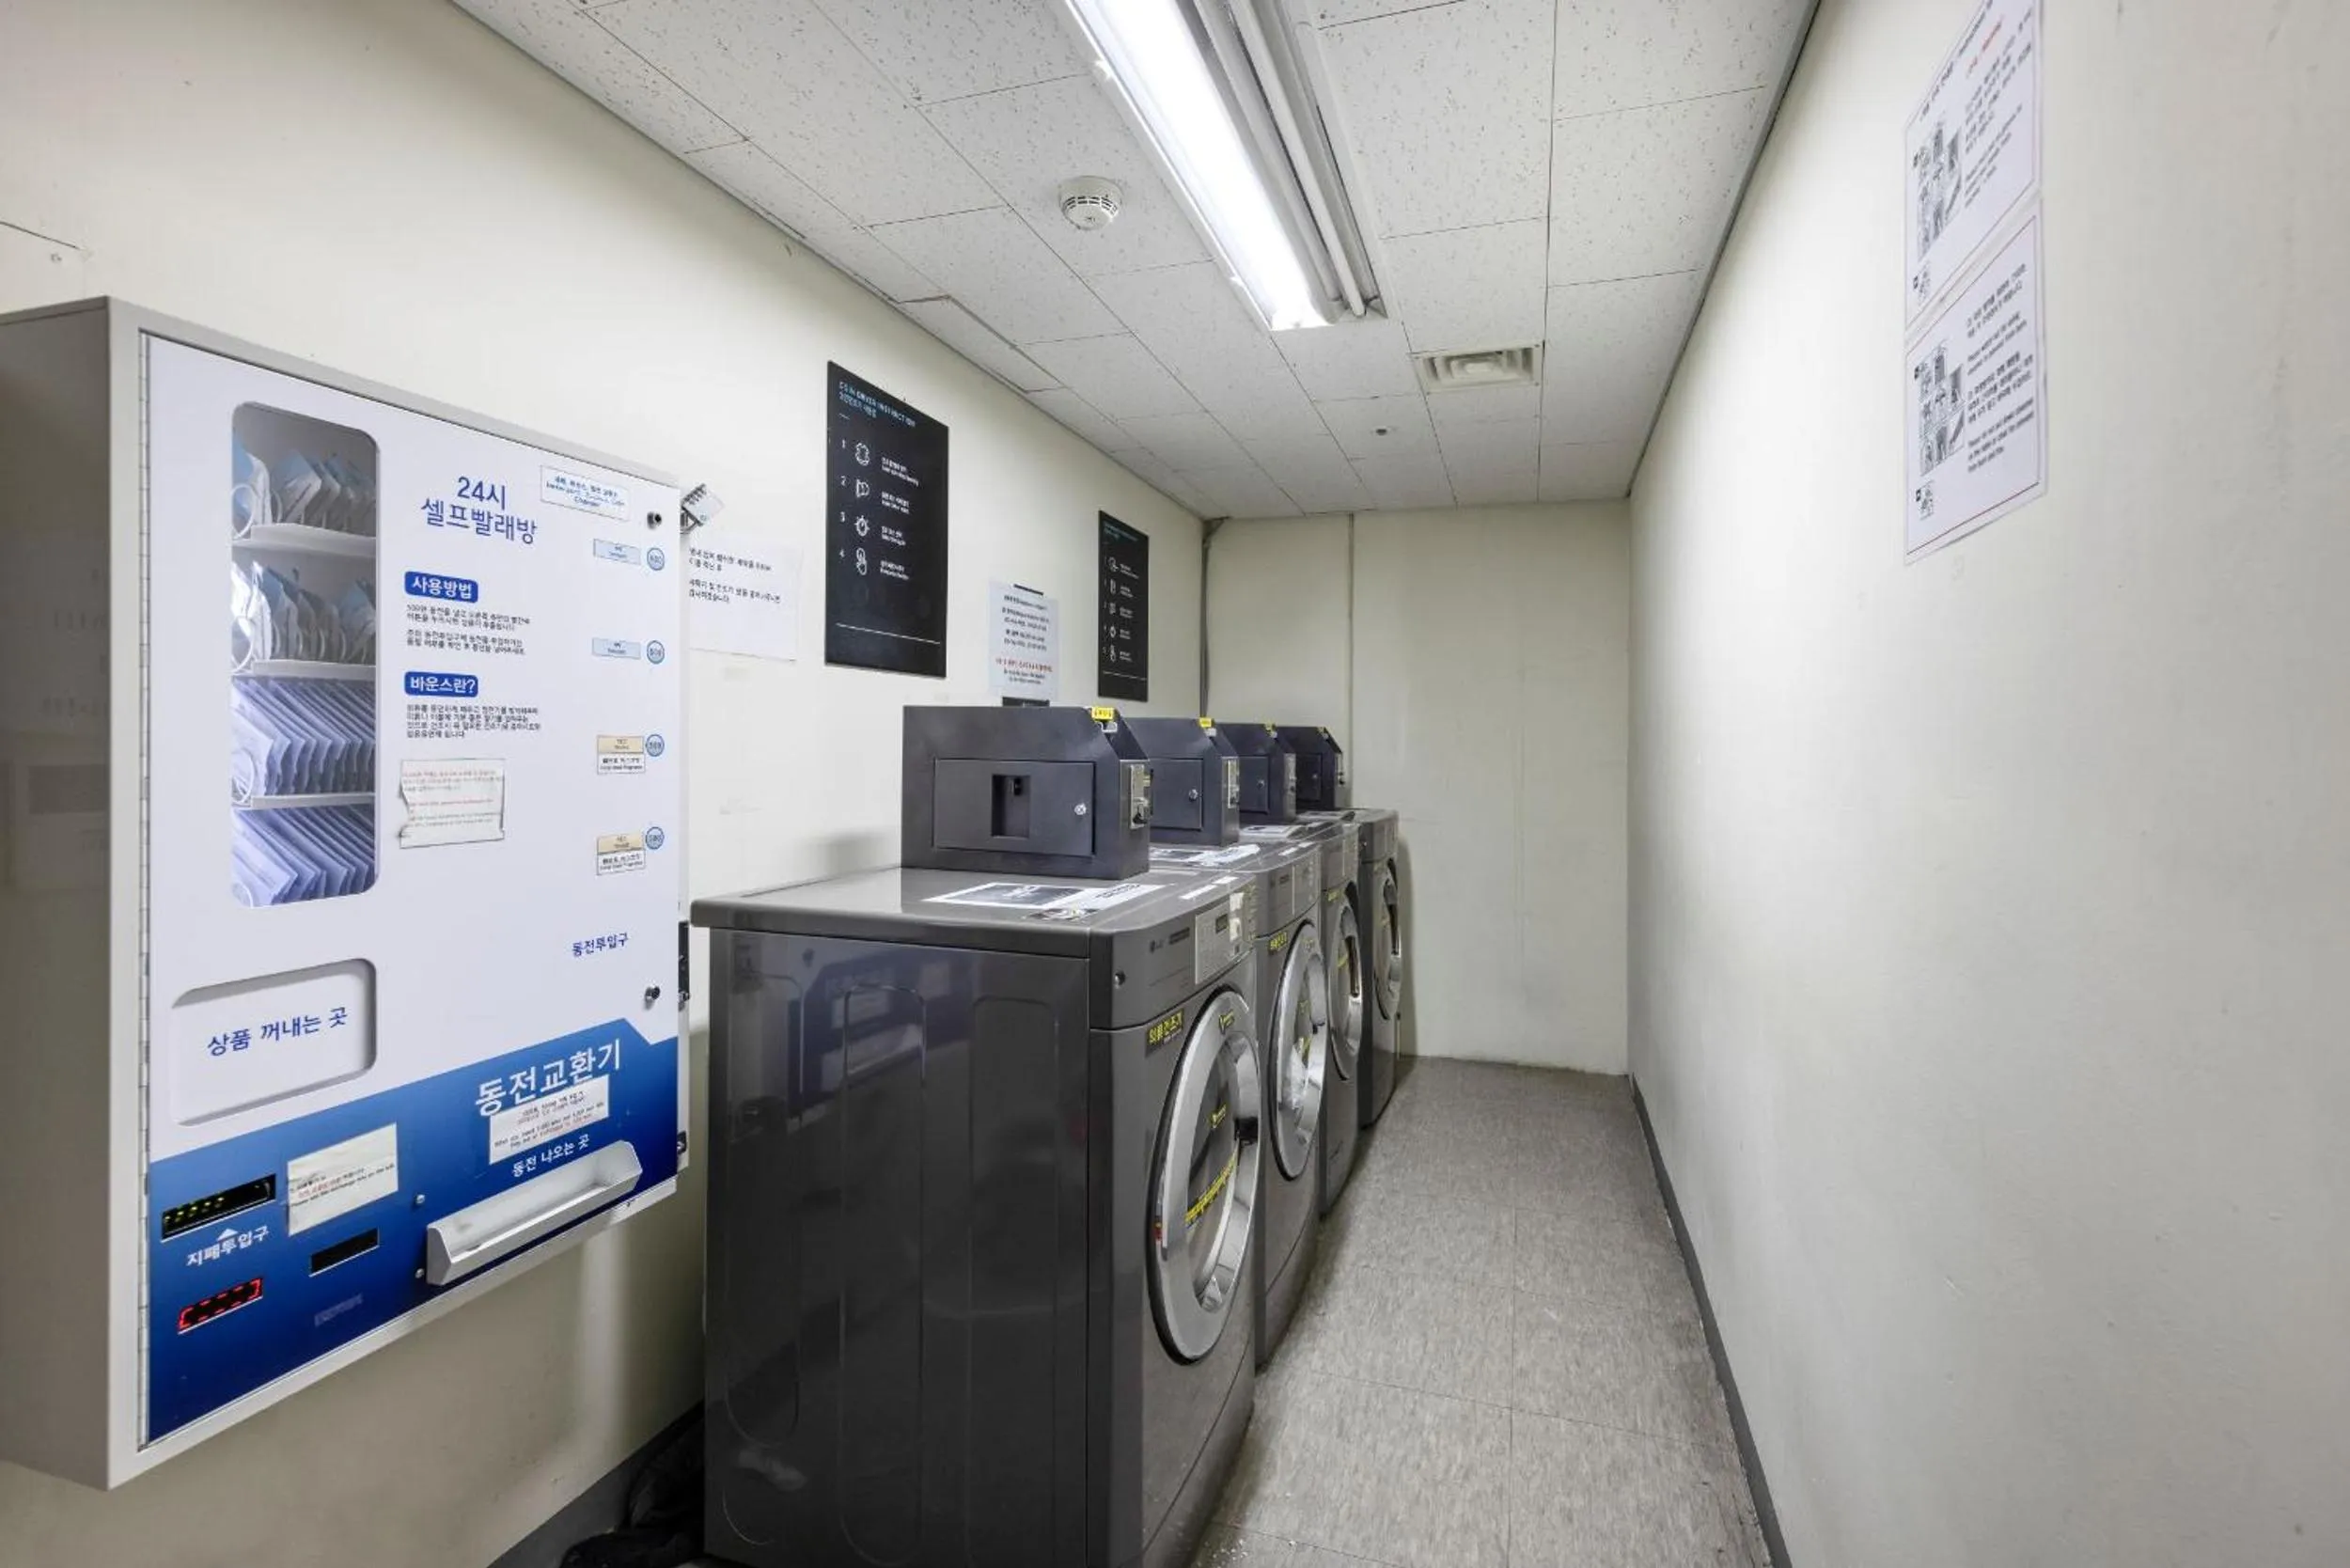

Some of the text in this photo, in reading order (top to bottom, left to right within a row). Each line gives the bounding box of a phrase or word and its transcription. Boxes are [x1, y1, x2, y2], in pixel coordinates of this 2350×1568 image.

[457, 477, 506, 510] 24시
[421, 498, 538, 545] 셀프빨래방
[412, 575, 473, 600] 사용방법
[411, 676, 475, 694] 바운스란?
[572, 933, 628, 957] 동전투입구
[208, 1007, 348, 1057] 상품 꺼내는 곳
[476, 1038, 620, 1116] 동전교환기
[512, 1133, 589, 1177] 동전 나오는 곳
[186, 1225, 270, 1266] 지폐투입구
